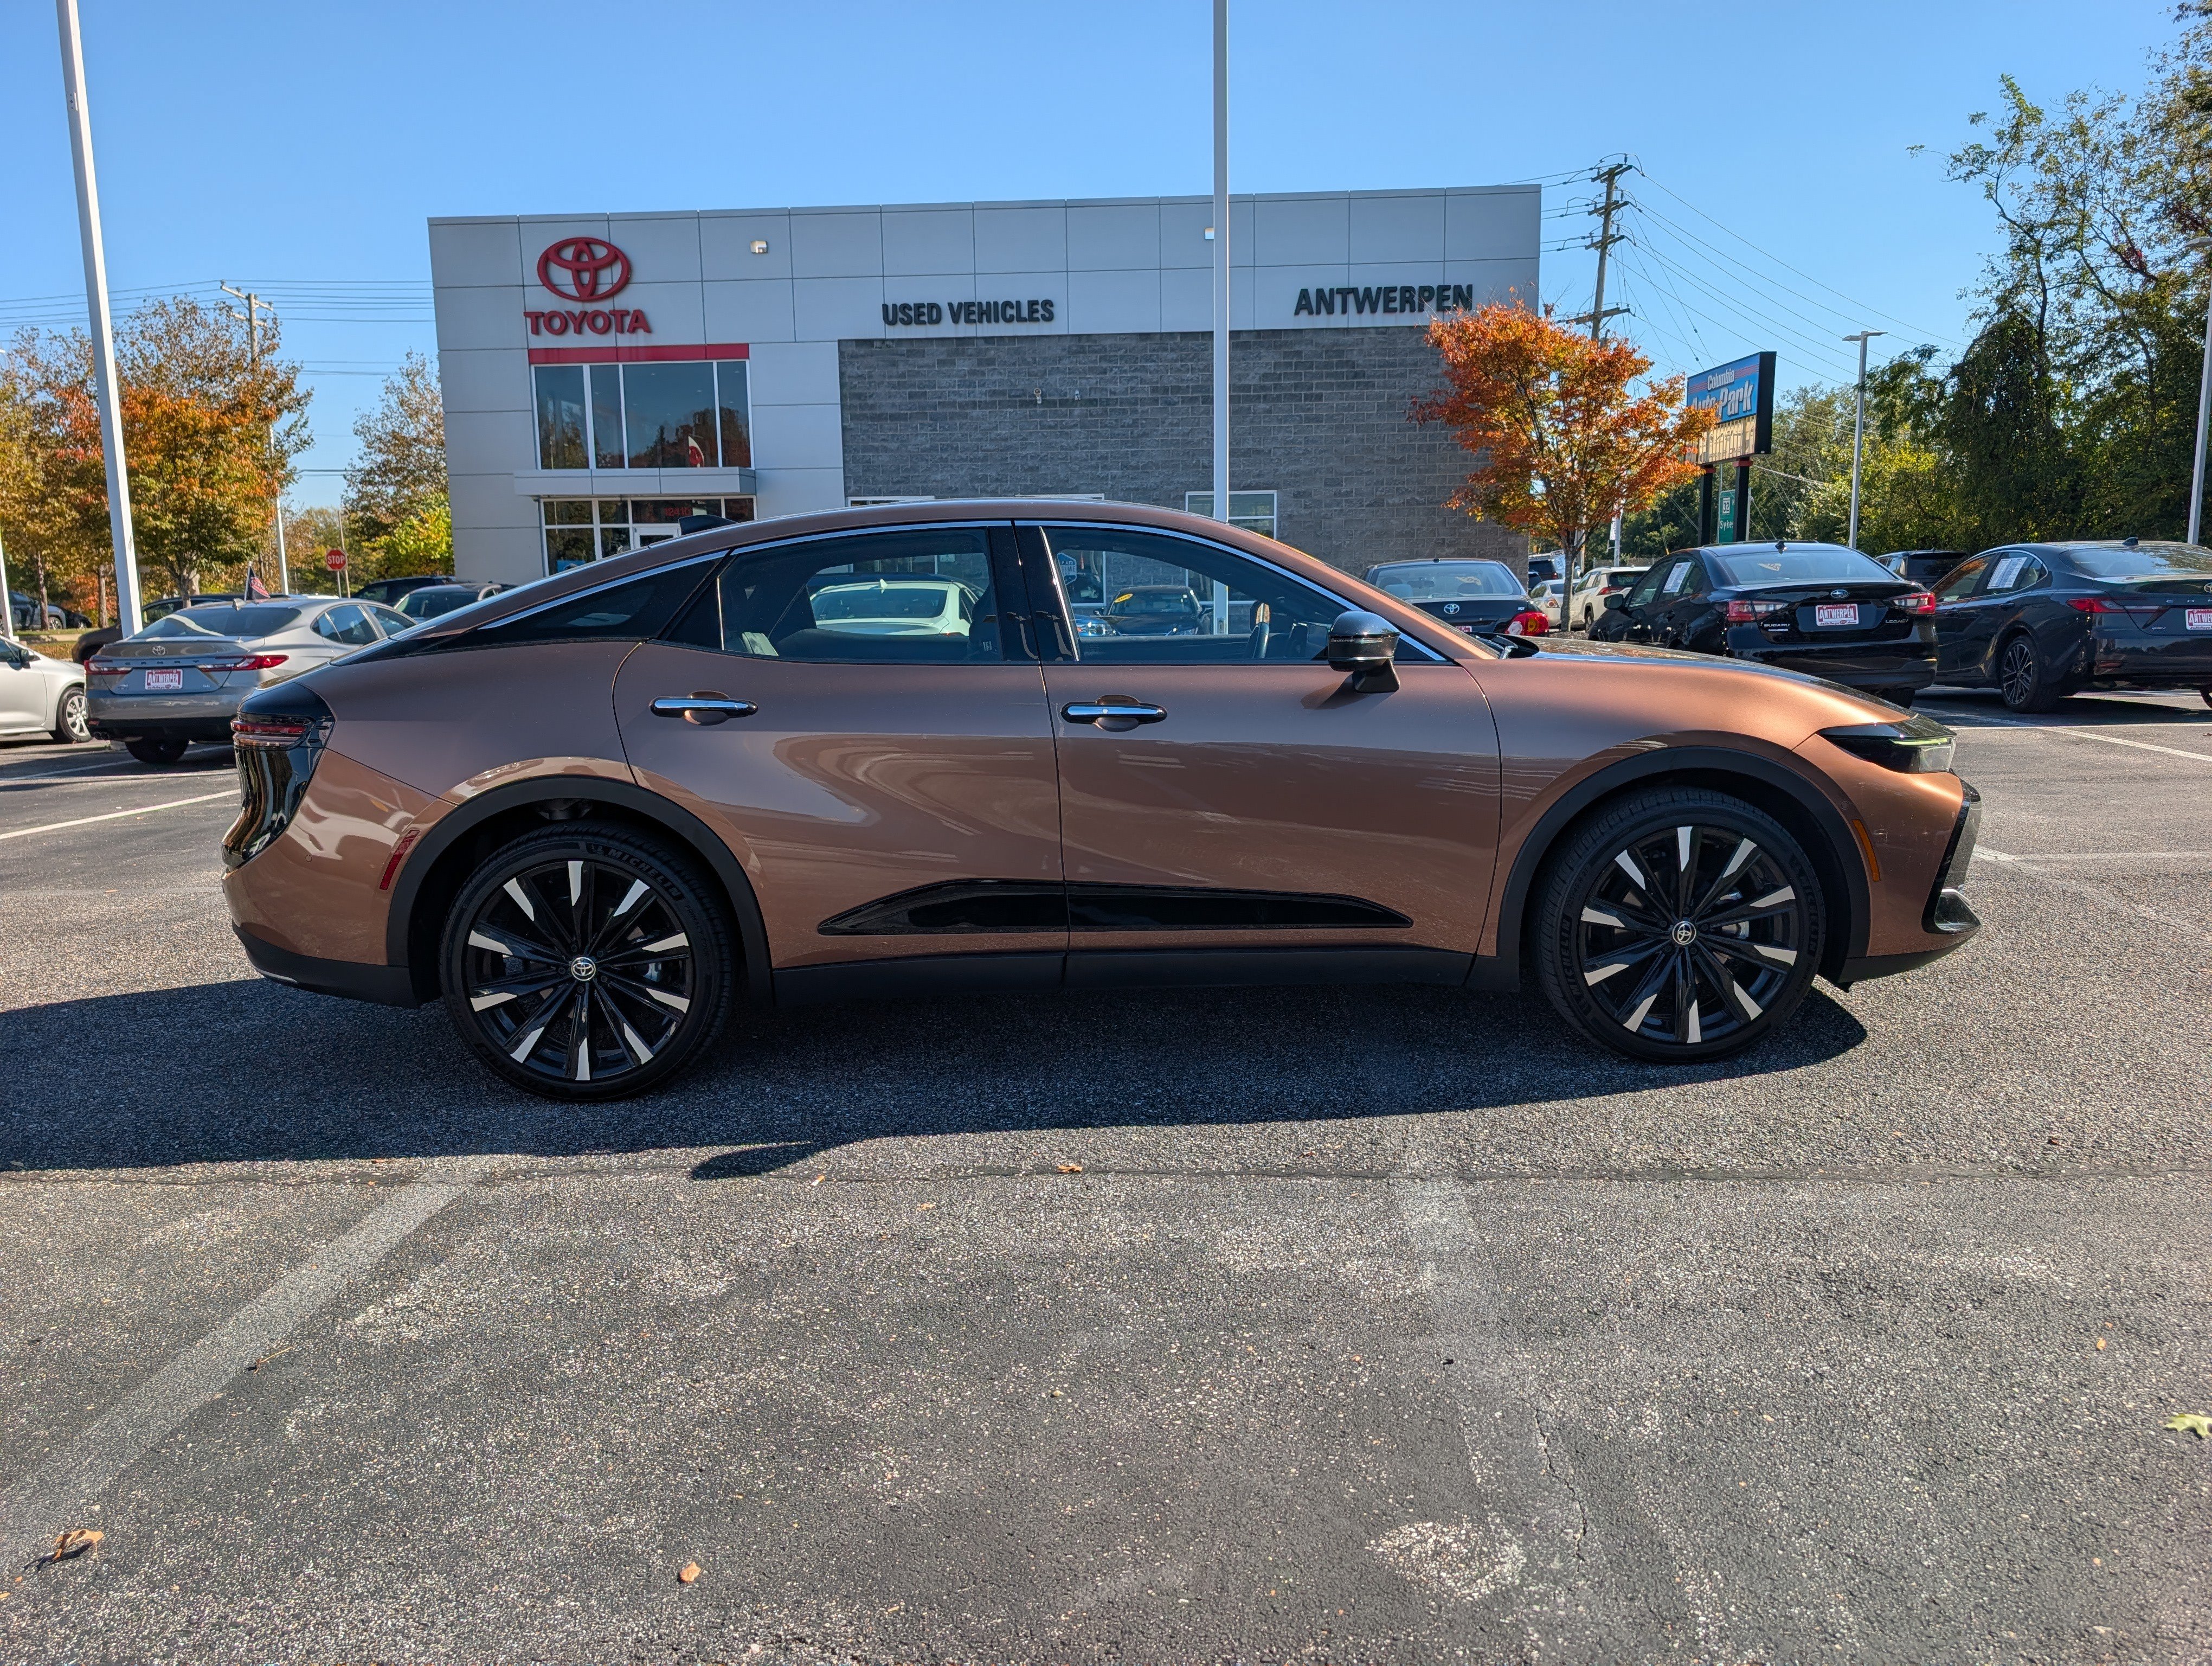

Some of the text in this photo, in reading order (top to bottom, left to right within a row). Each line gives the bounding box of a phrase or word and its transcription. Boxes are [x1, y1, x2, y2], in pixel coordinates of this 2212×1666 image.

[882, 299, 1054, 325] USED VEHICLES
[1294, 284, 1473, 315] ANTWERPEN
[524, 309, 652, 336] TOYOTA
[1707, 368, 1735, 390] Columbia
[1718, 380, 1753, 419] Park
[1723, 502, 1729, 511] 32
[327, 555, 345, 564] STOP
[1819, 608, 1854, 619] ANTWERPEN
[147, 673, 179, 683] ANTWERPEN
[608, 848, 681, 898] MICHELIN
[1560, 917, 1581, 996] MICHELIN
